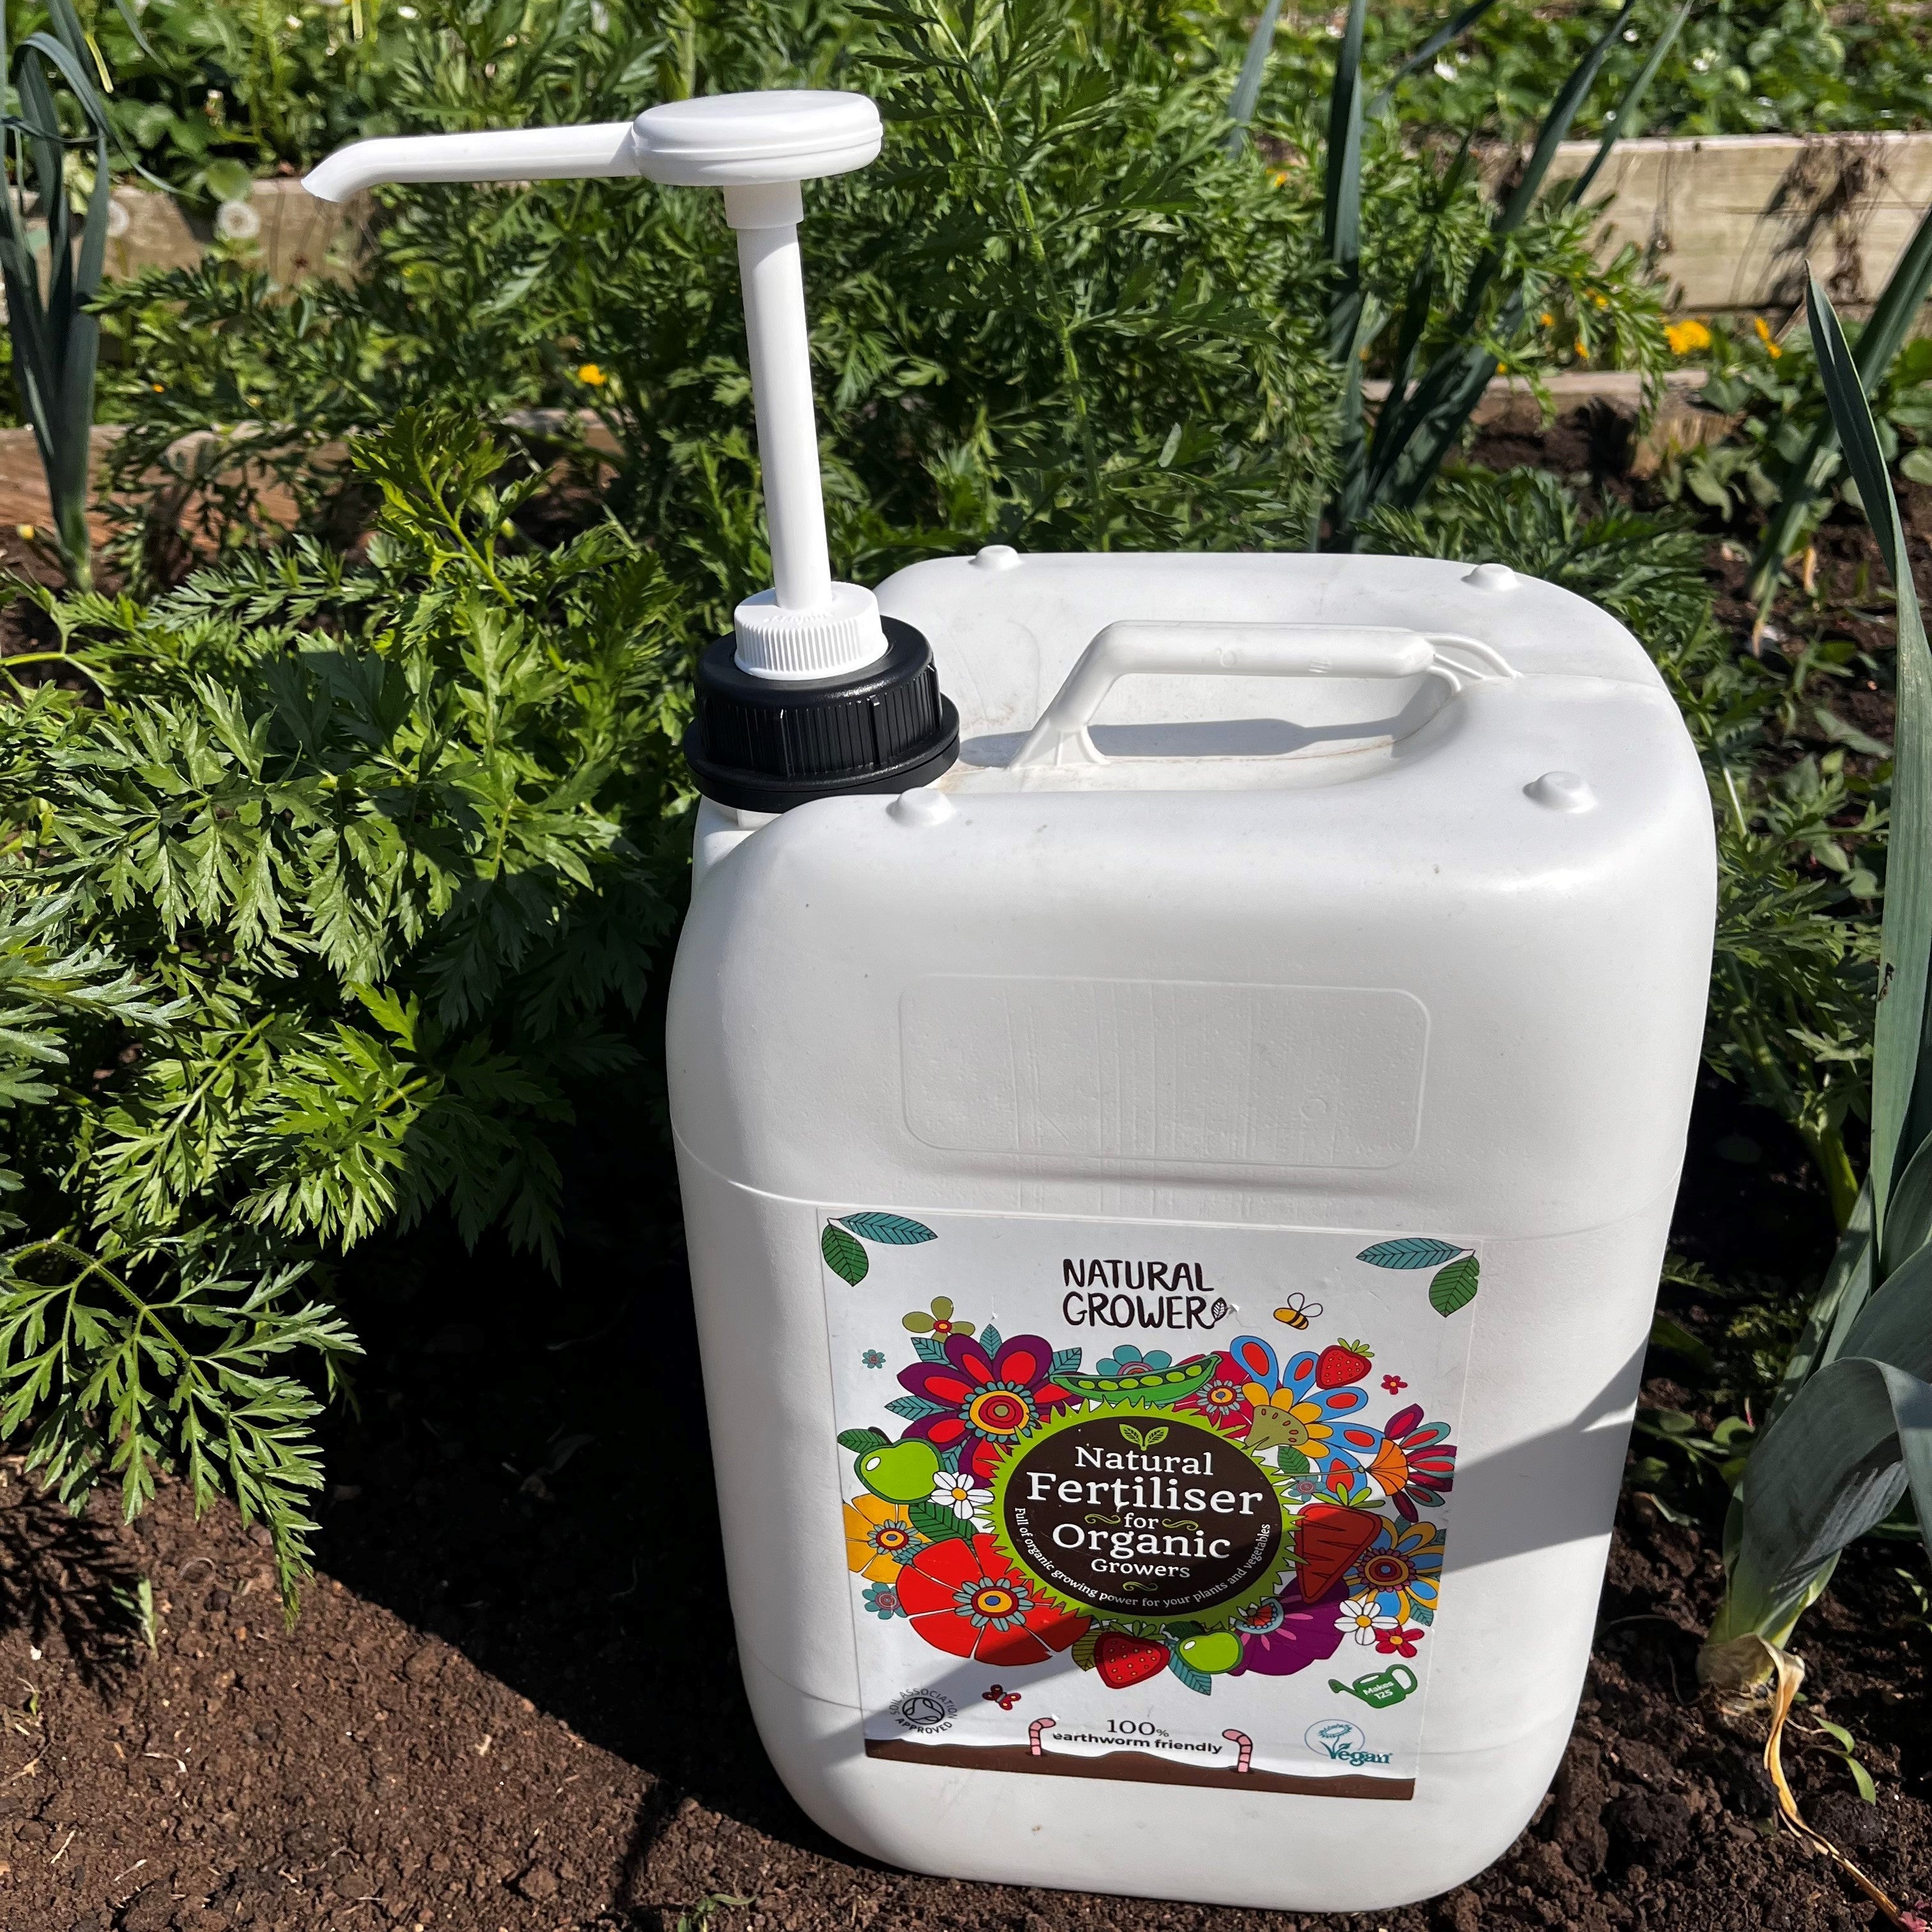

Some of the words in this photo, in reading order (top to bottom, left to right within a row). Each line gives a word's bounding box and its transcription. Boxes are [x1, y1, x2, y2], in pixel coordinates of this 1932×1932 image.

[1062, 1258, 1215, 1291] NATURAL
[1062, 1291, 1216, 1330] GROWER
[1074, 1446, 1214, 1476] Natural
[1026, 1471, 1263, 1515] Fertiliser
[1015, 1507, 1029, 1526] Full
[1124, 1512, 1160, 1529] for
[1019, 1527, 1034, 1537] of
[1052, 1522, 1231, 1560] Organic
[1024, 1538, 1055, 1571] organic
[1243, 1524, 1271, 1569] vegetables
[1091, 1558, 1191, 1579] Growers
[1227, 1567, 1247, 1584] and
[1051, 1569, 1099, 1598] growing
[1192, 1582, 1228, 1602] plants
[1099, 1592, 1138, 1606] power
[1142, 1597, 1160, 1607] for
[1163, 1596, 1191, 1608] your
[1363, 1681, 1394, 1695] Makes
[1374, 1689, 1393, 1699] 125
[889, 1699, 903, 1715] SOIL
[899, 1687, 958, 1720] ASSOCIATION
[894, 1717, 953, 1734] APPROVED
[1107, 1719, 1170, 1738] 100%
[1053, 1732, 1151, 1748] earthworm
[1154, 1738, 1223, 1754] friendly
[1319, 1741, 1391, 1767] Vegan
